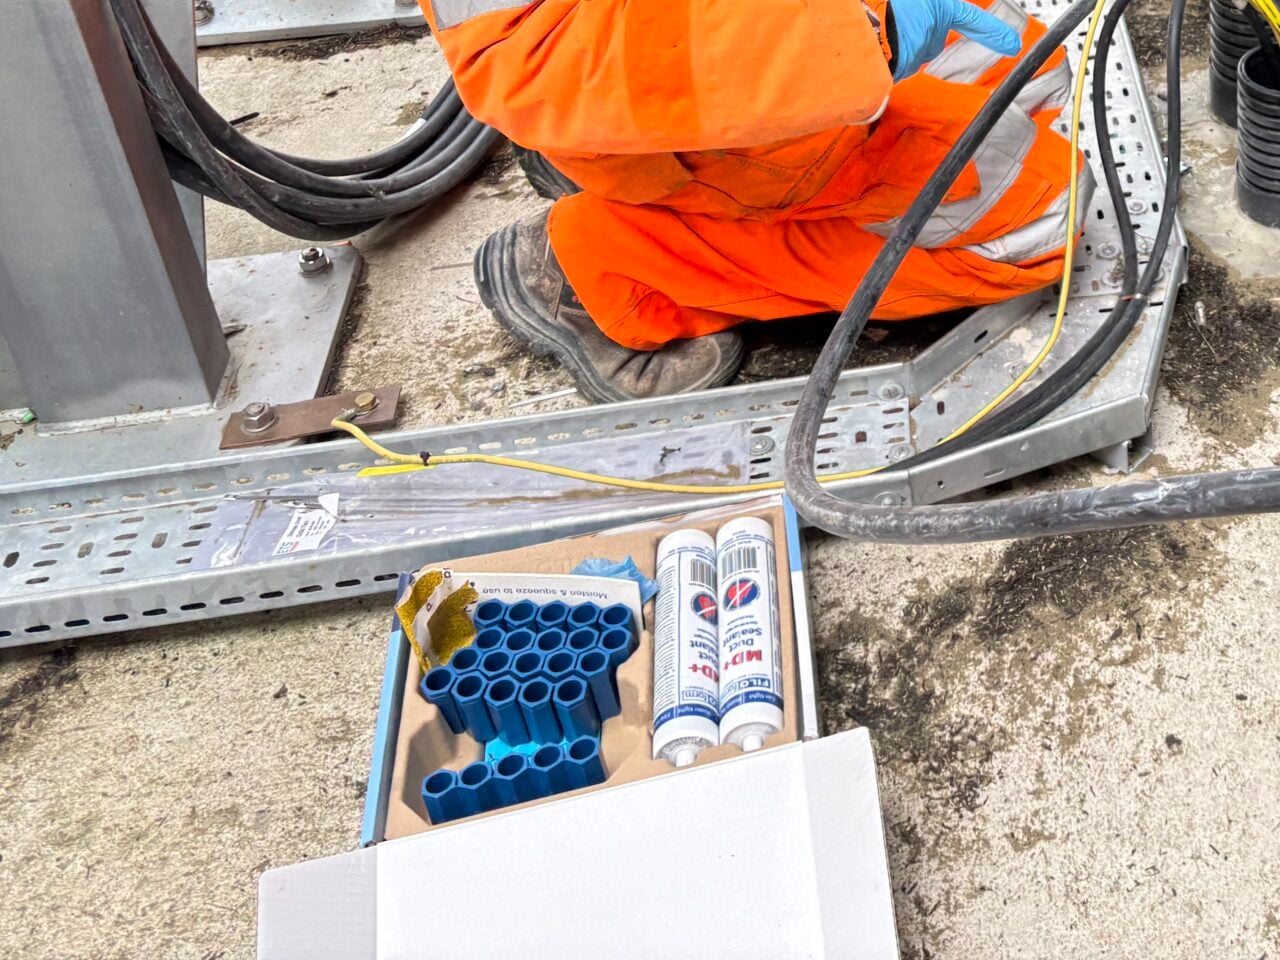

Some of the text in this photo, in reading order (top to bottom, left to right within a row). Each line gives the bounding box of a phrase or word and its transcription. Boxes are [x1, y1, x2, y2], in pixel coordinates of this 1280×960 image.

[515, 587, 558, 595] squeeze
[569, 590, 608, 599] Moisten
[723, 627, 763, 647] Sealant
[729, 638, 754, 652] Duct
[697, 651, 718, 665] uct
[723, 649, 763, 671] MD+
